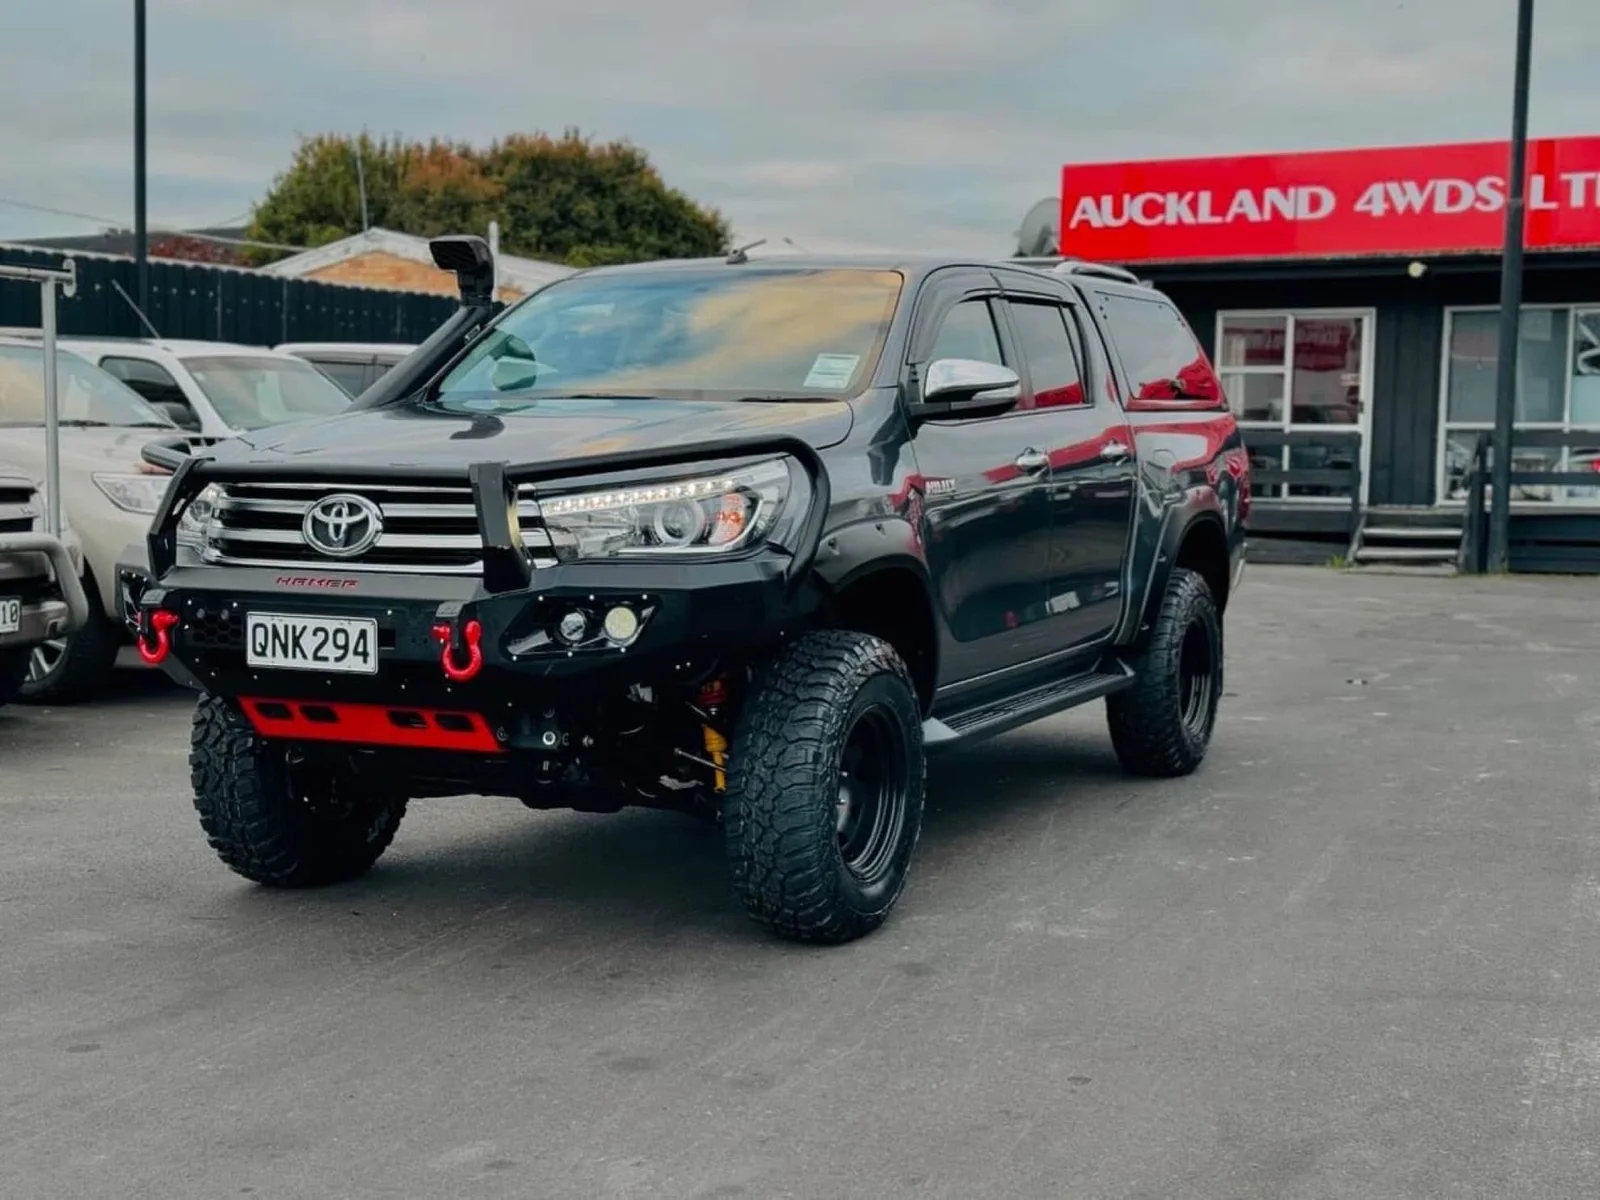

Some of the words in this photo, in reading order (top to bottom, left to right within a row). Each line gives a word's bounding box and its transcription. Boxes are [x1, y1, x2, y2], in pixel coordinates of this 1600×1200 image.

[1069, 185, 1336, 229] AUCKLAND
[1354, 175, 1505, 217] 4WDS
[1529, 172, 1600, 210] LT
[252, 622, 370, 664] QNK294
